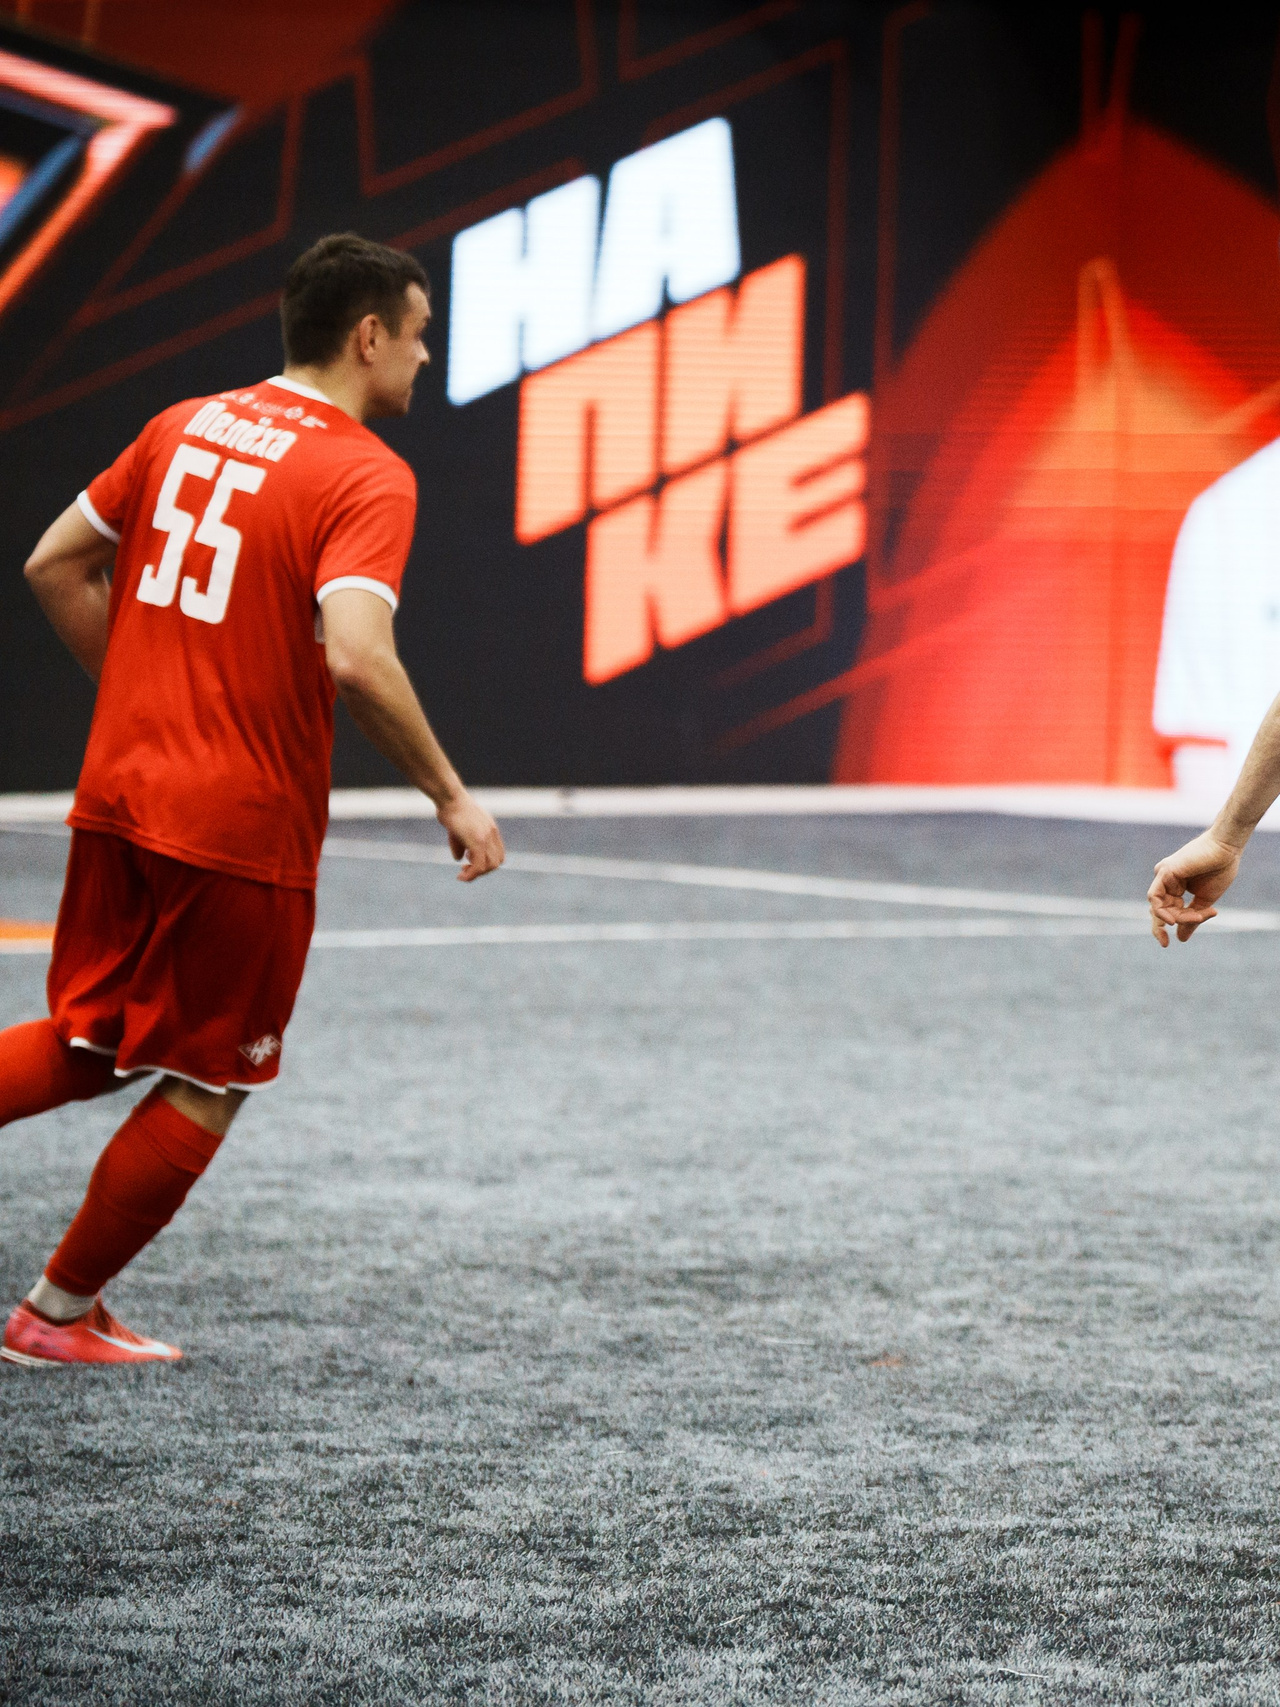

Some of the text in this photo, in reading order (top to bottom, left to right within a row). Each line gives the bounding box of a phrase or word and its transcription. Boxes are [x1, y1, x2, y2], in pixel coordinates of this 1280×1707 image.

[447, 117, 741, 407] НА
[515, 252, 807, 546] ПИ
[136, 443, 267, 625] 55
[583, 389, 871, 687] КЕ
